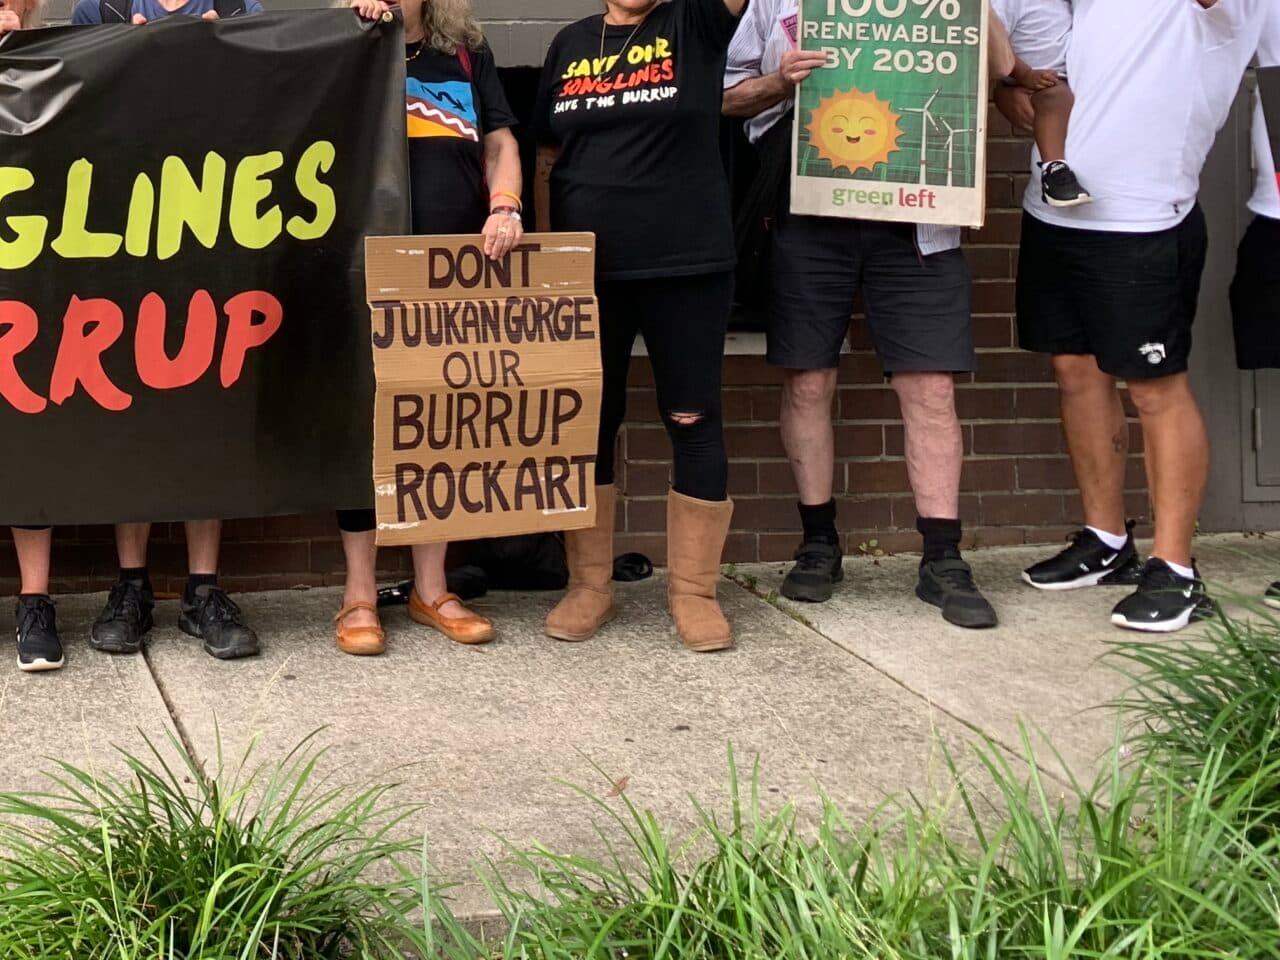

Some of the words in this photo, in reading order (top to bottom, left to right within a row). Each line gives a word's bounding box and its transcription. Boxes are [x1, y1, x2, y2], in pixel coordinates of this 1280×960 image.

[803, 21, 980, 46] RENEWABLES
[559, 58, 674, 97] SONGLINES
[821, 46, 862, 70] BY
[872, 48, 958, 75] 2030
[554, 99, 578, 114] SAVE
[585, 95, 616, 110] THE
[622, 86, 678, 105] BURRUP
[832, 187, 894, 207] green
[898, 187, 936, 209] left
[428, 243, 541, 289] DONT
[442, 349, 524, 389] OUR
[392, 387, 583, 451] BURRUP
